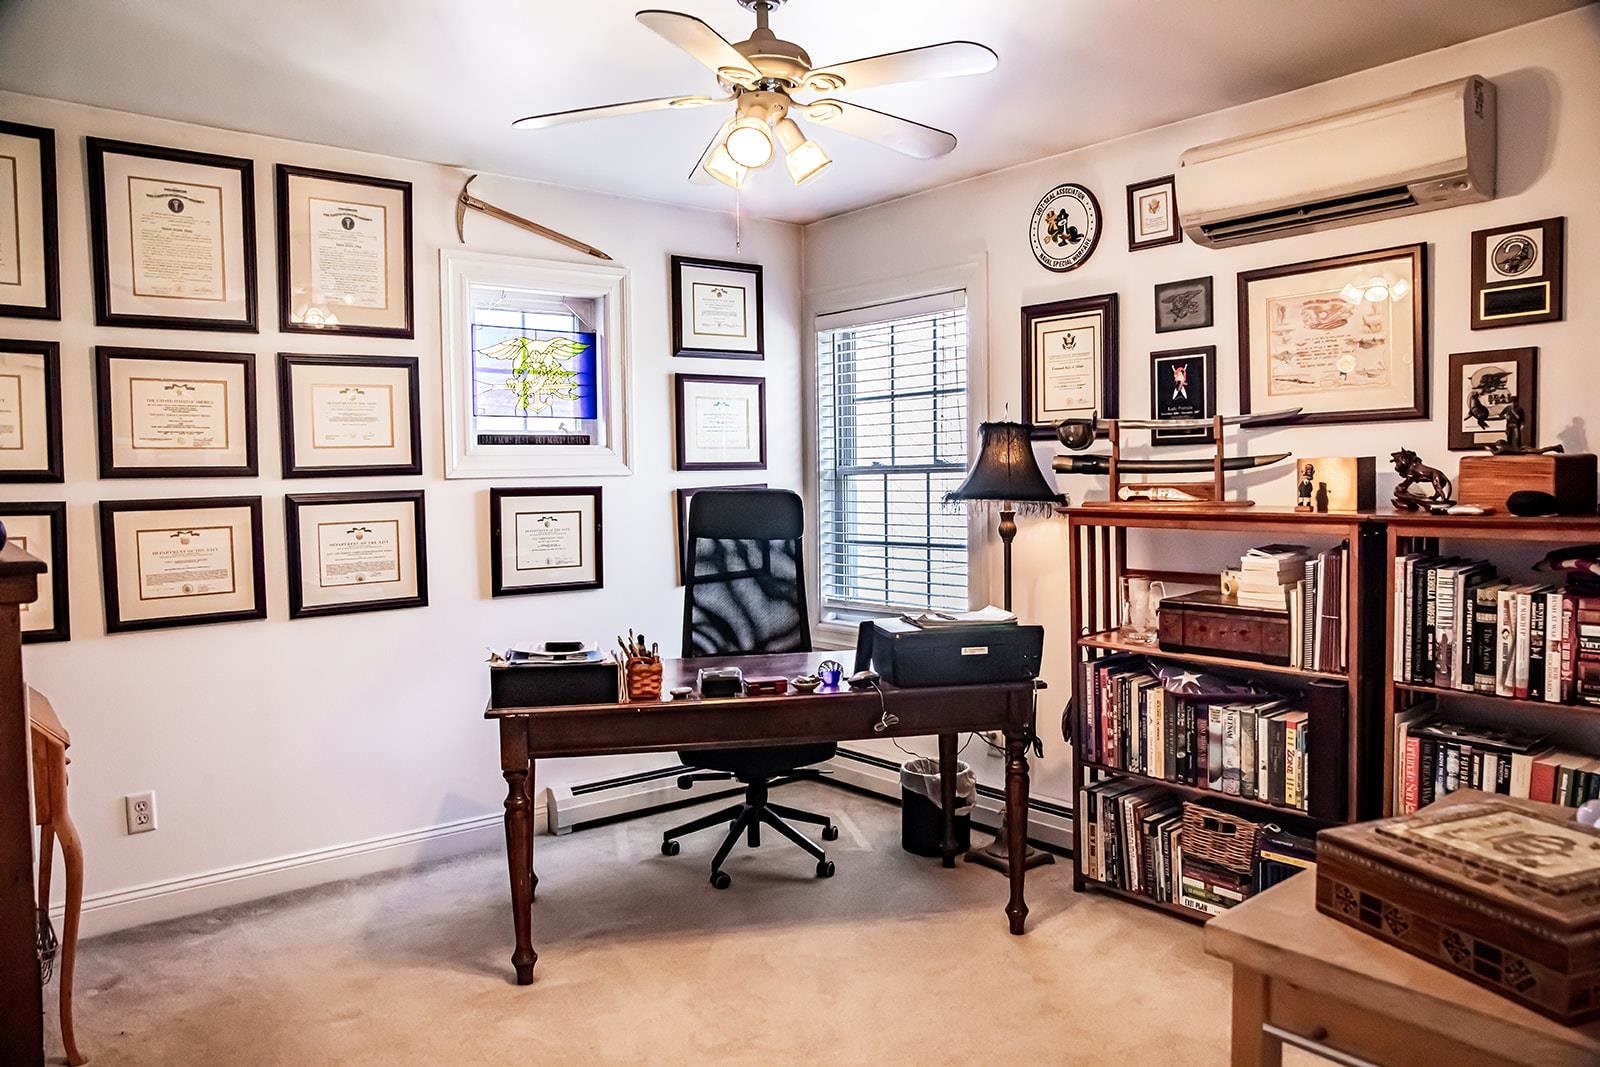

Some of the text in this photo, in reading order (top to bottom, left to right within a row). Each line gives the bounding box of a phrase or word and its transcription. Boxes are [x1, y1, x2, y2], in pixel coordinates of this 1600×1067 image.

[1056, 187, 1086, 200] ASSOCIATION
[1039, 252, 1052, 266] NAVAL
[1072, 238, 1092, 262] WARFARE
[1483, 629, 1492, 670] The Arabs
[1287, 749, 1295, 774] ZONE
[1406, 738, 1418, 800] Fortunate Son
[1460, 756, 1469, 784] FUTURE
[1184, 899, 1208, 912] EXIT PLAN
